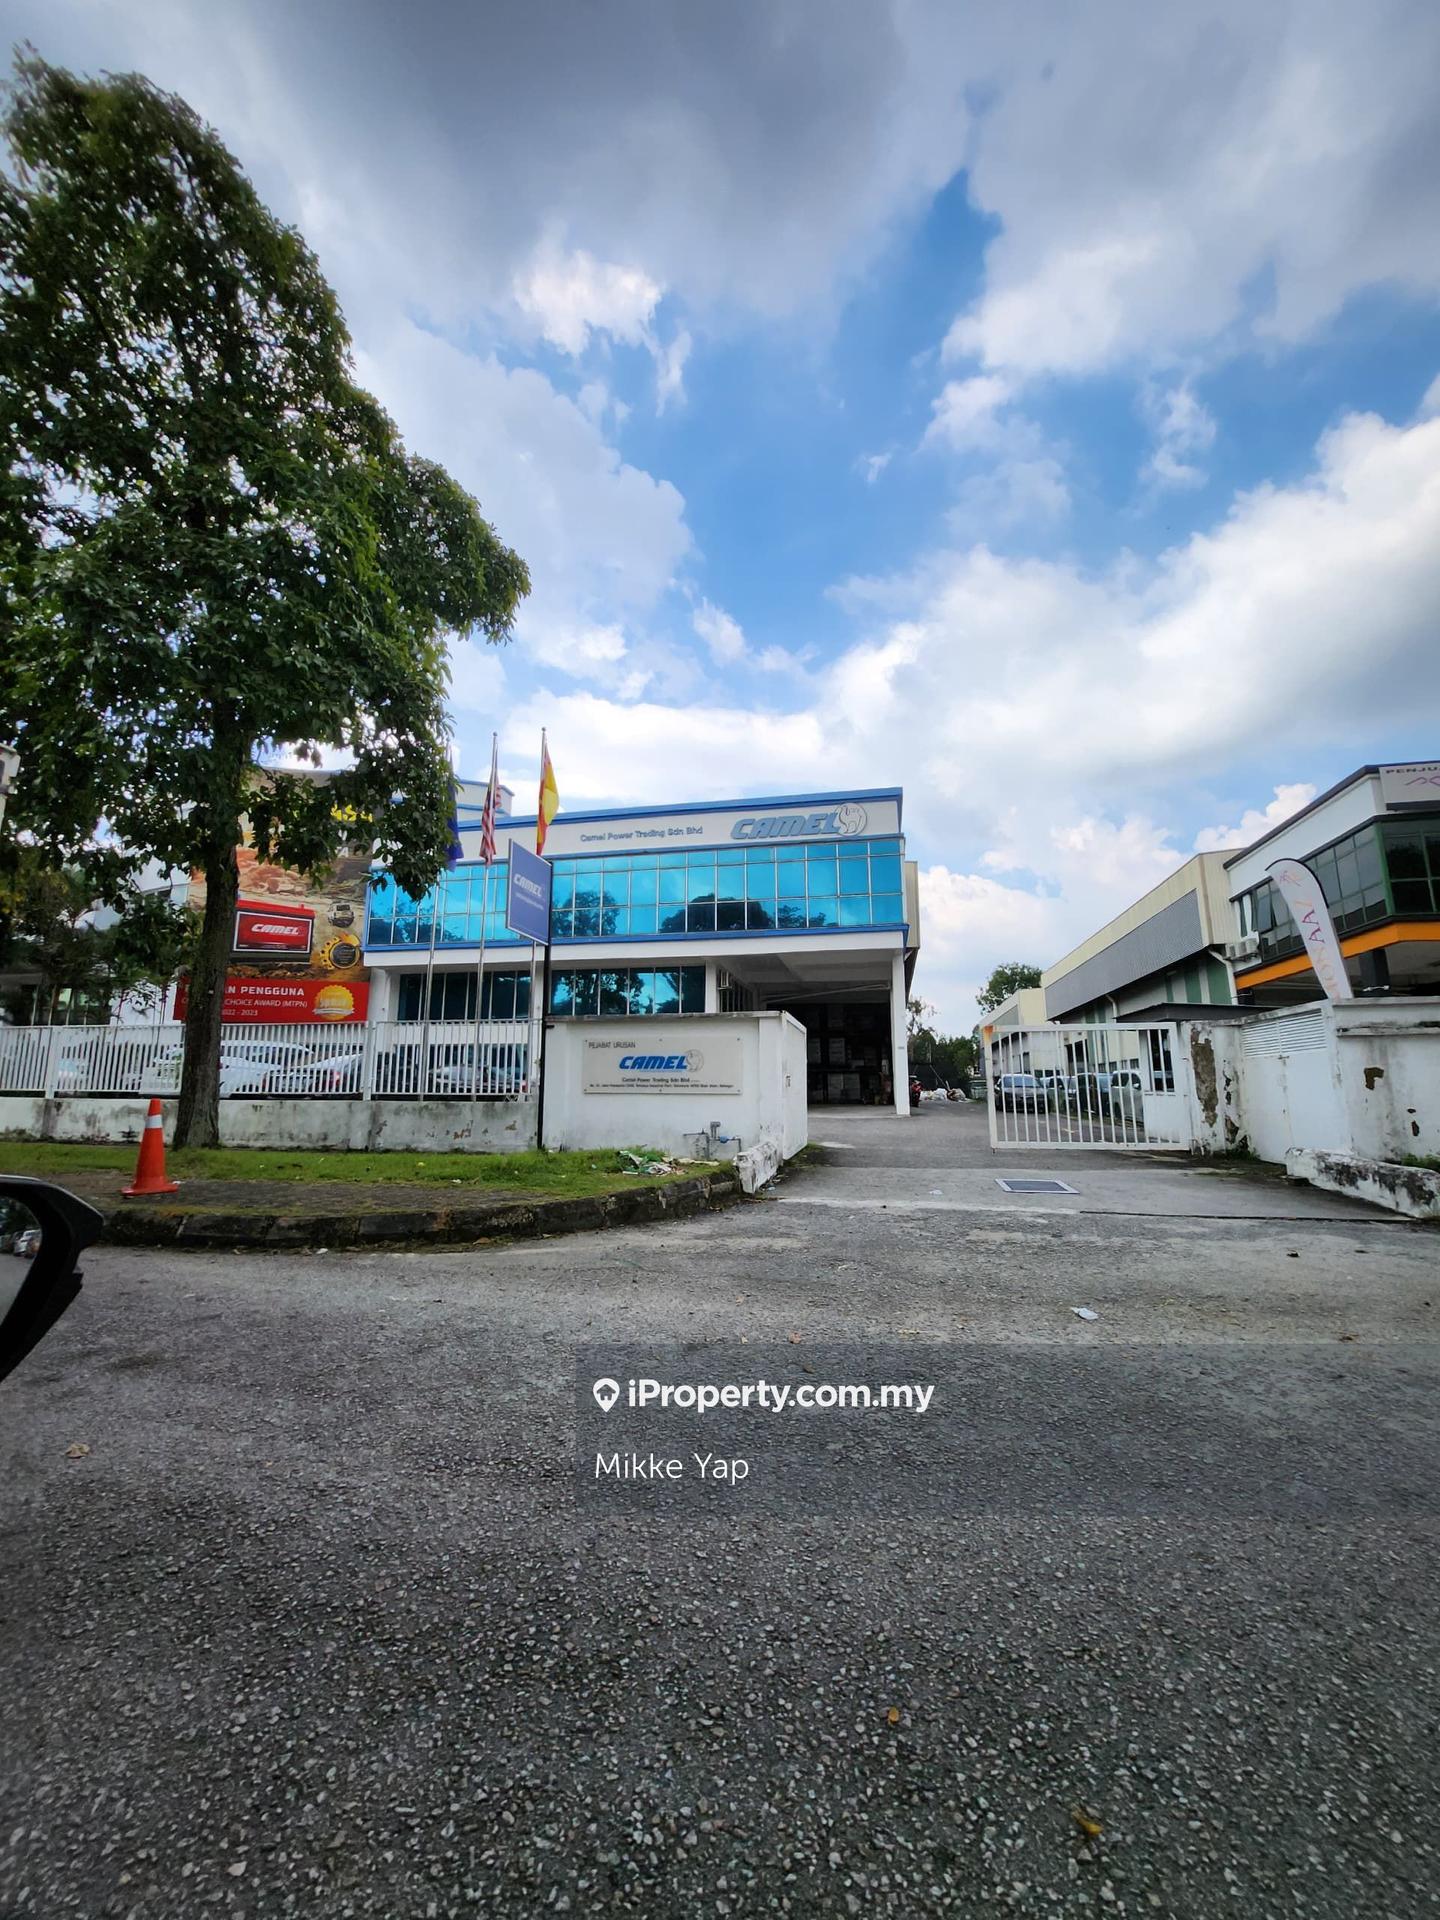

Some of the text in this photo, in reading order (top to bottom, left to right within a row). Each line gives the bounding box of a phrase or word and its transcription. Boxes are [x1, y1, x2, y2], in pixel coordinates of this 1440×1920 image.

[731, 812, 841, 839] CAMEL
[580, 826, 703, 842] Camel Power Trading Sdn Bhd
[513, 873, 542, 897] CAMEL
[251, 923, 299, 935] CAMEL
[240, 986, 304, 996] PENGGUNA
[253, 999, 281, 1007] AWARD
[588, 1041, 611, 1049] PEJABAT
[619, 1055, 687, 1070] CAMEL
